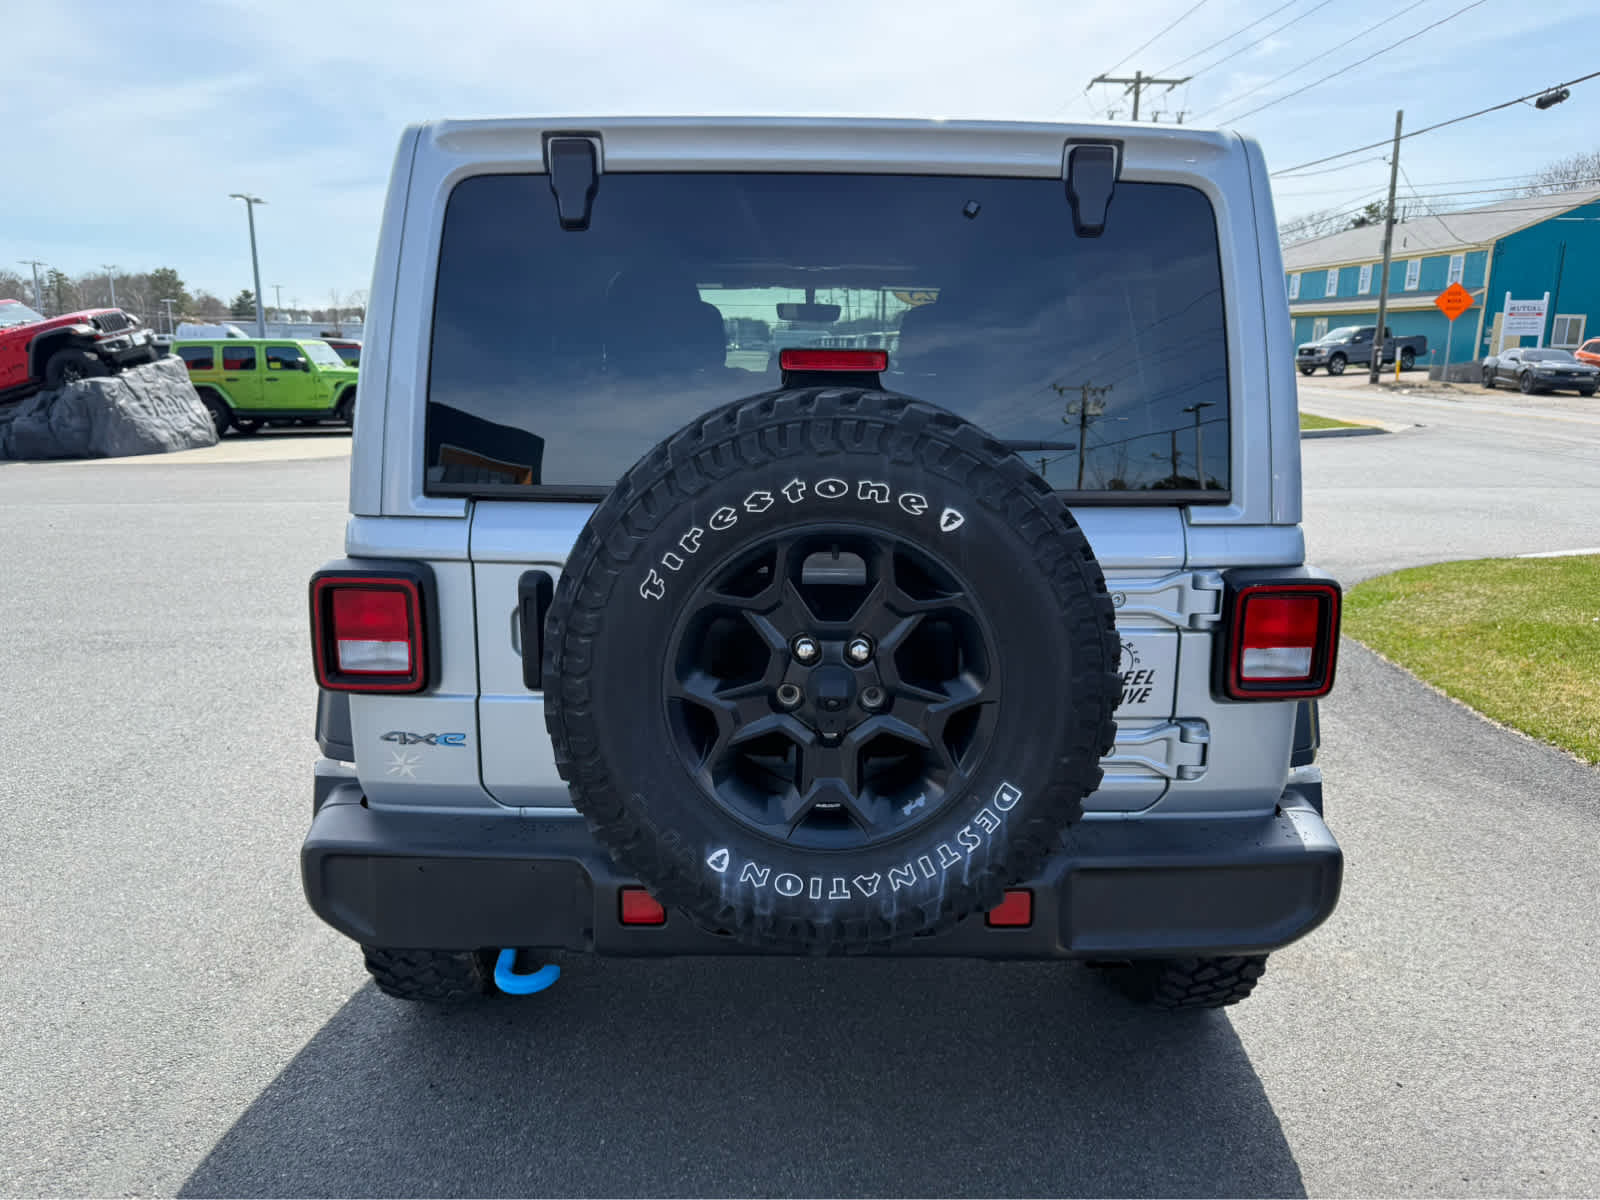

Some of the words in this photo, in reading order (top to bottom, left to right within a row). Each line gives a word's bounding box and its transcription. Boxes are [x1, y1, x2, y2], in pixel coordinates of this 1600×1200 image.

[640, 478, 928, 600] Firestone
[1120, 687, 1153, 705] IVE
[1121, 669, 1155, 686] EEL
[740, 782, 1022, 900] DESTINATION
